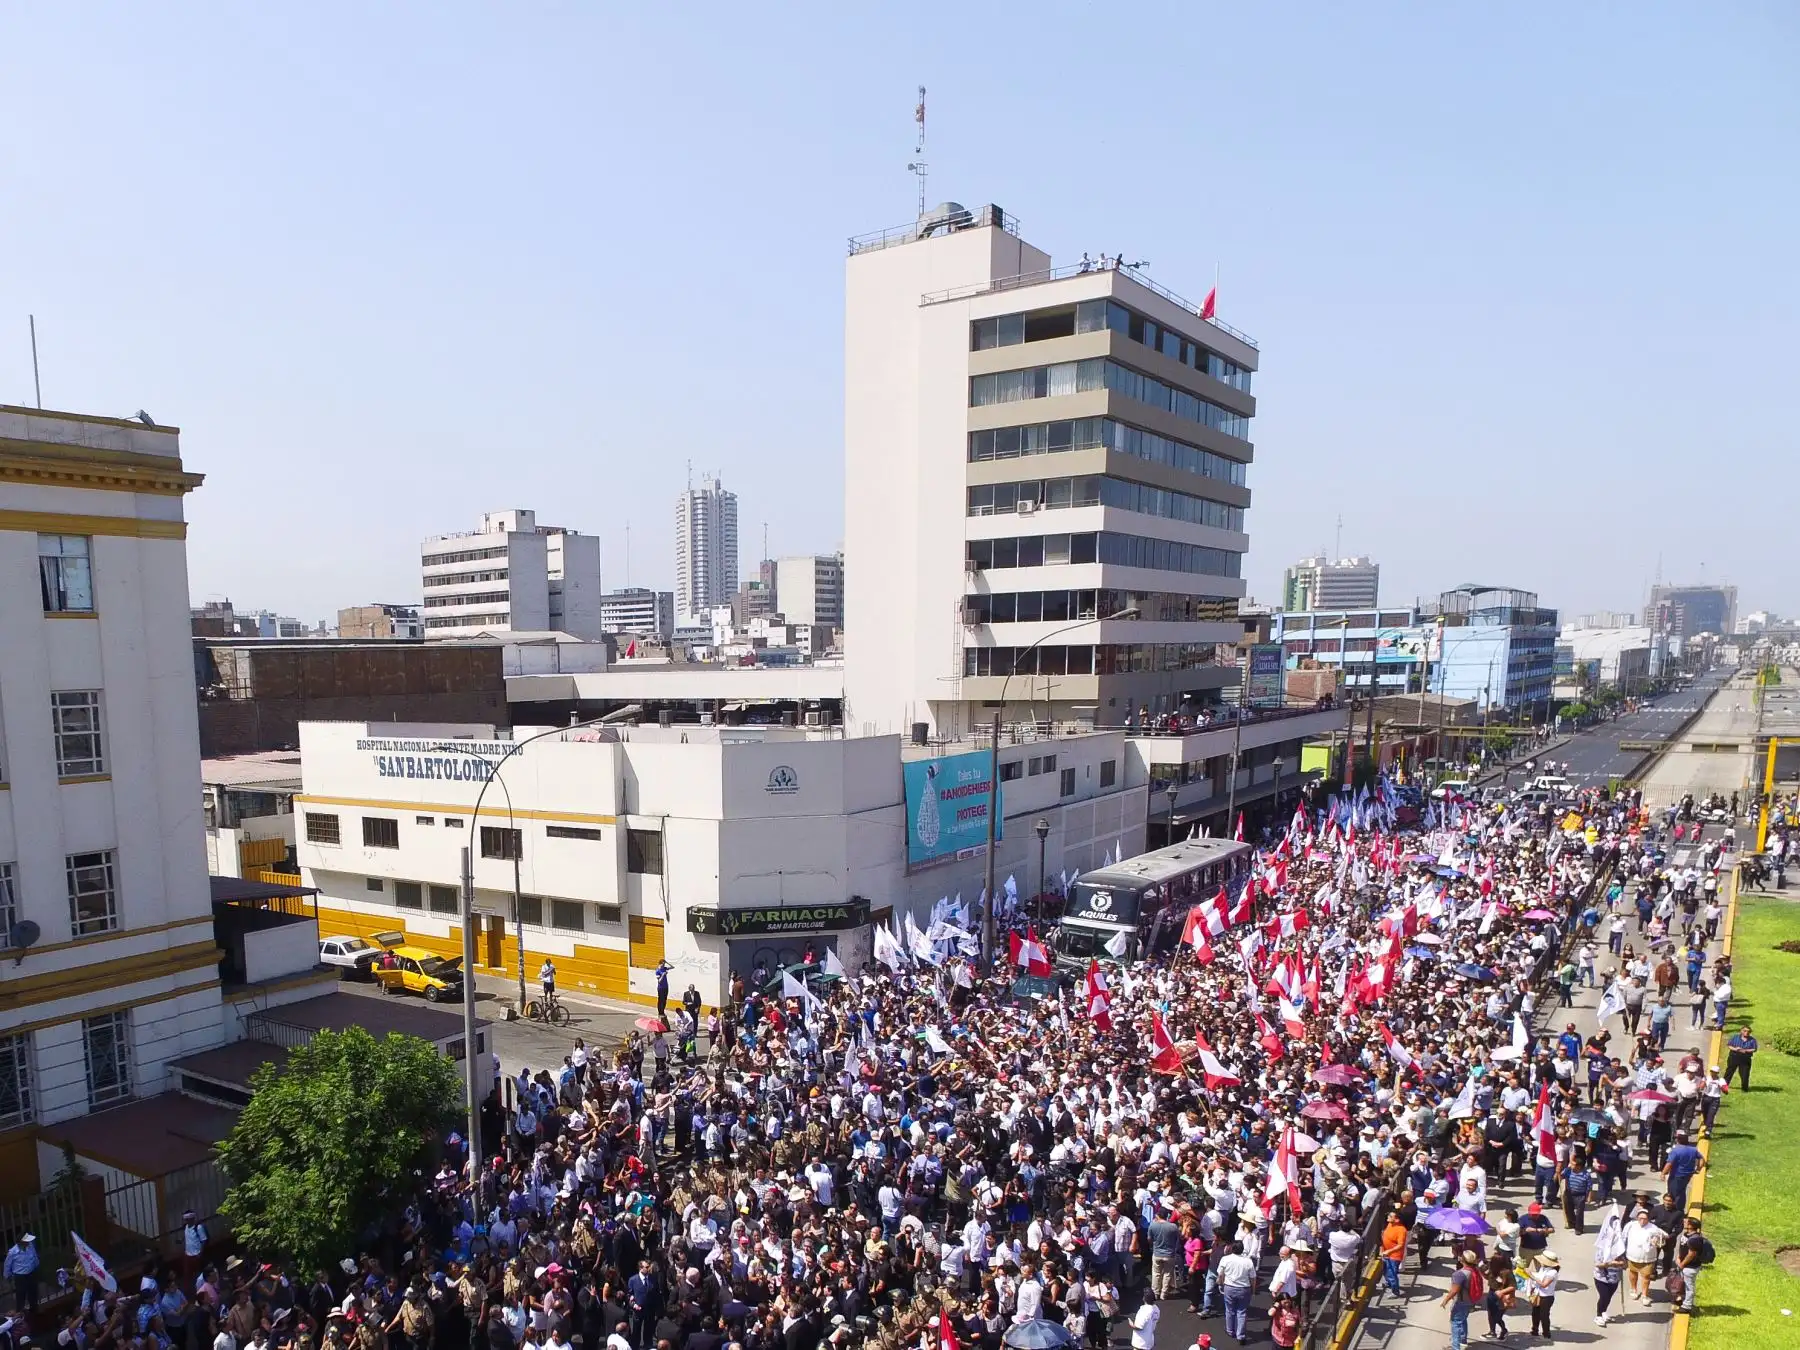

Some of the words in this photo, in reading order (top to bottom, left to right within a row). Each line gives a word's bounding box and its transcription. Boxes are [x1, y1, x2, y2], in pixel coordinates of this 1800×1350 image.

[357, 740, 392, 751] HOSPITAL
[393, 741, 432, 752] NACIONAL
[470, 743, 501, 755] MADRE
[741, 908, 849, 923] FARMACIA
[1078, 910, 1119, 922] AQUILES
